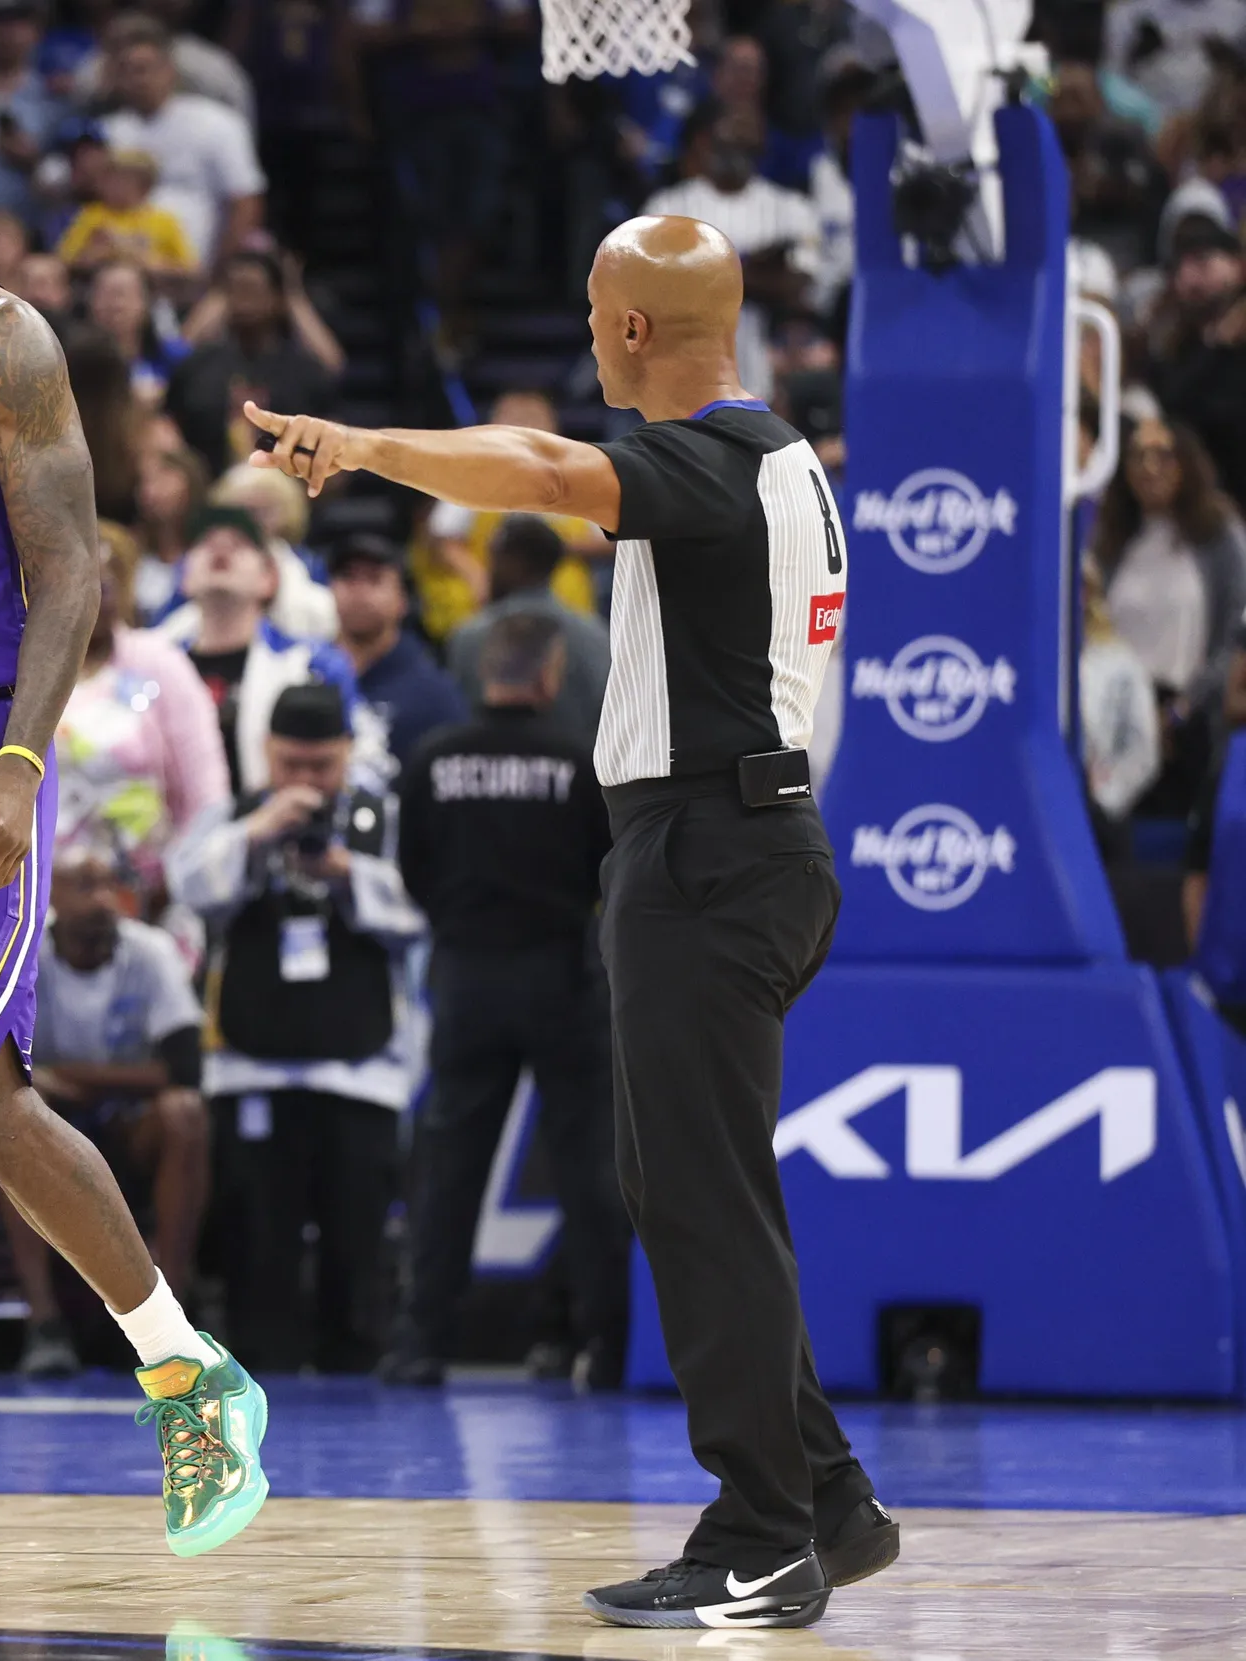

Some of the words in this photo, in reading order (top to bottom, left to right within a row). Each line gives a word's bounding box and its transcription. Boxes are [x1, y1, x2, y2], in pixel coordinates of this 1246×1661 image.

[809, 469, 842, 574] 8
[430, 754, 575, 803] SECURITY
[772, 1064, 1156, 1183] KIA
